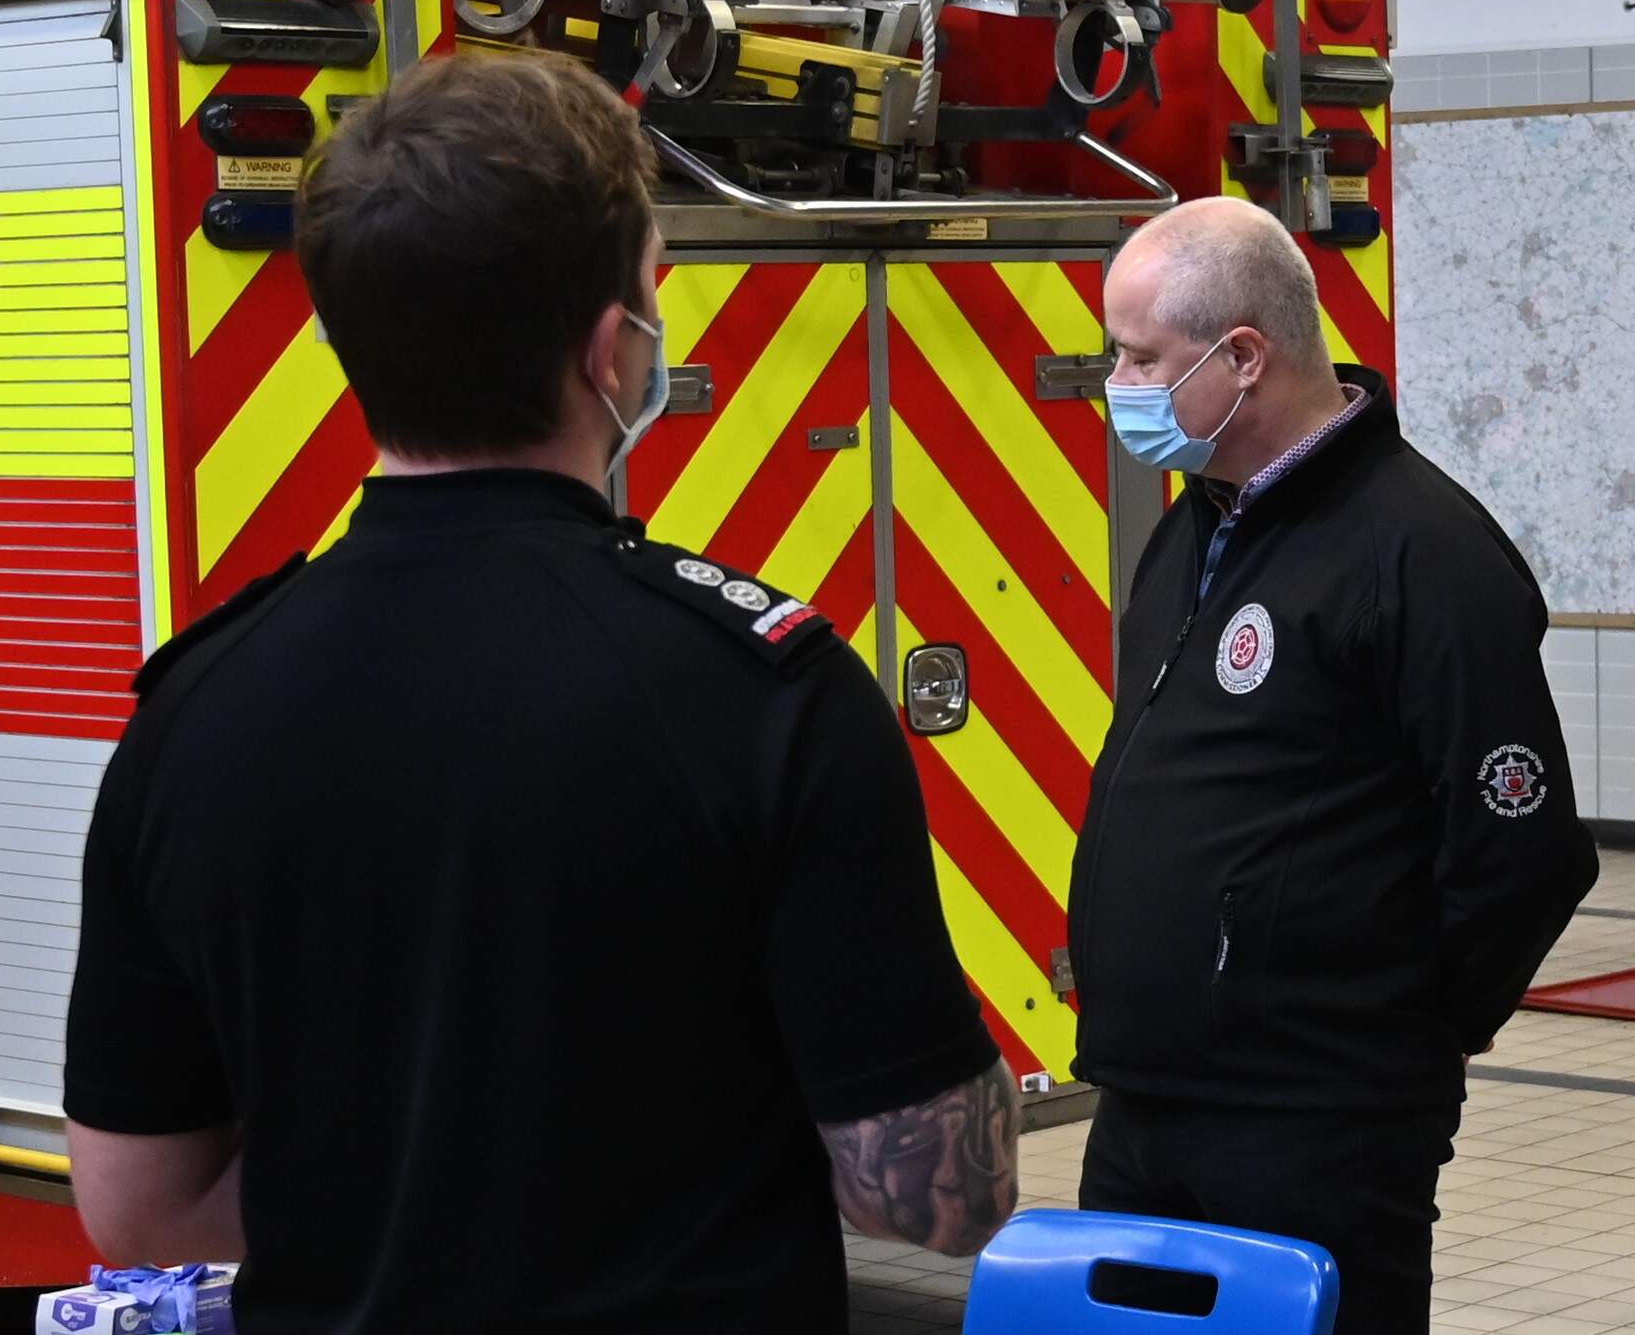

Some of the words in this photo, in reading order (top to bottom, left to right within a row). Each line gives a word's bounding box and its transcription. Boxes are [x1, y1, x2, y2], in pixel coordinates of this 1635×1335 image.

[245, 161, 292, 173] WARNING
[1476, 743, 1545, 782] Northamptonshire
[1495, 807, 1518, 818] and
